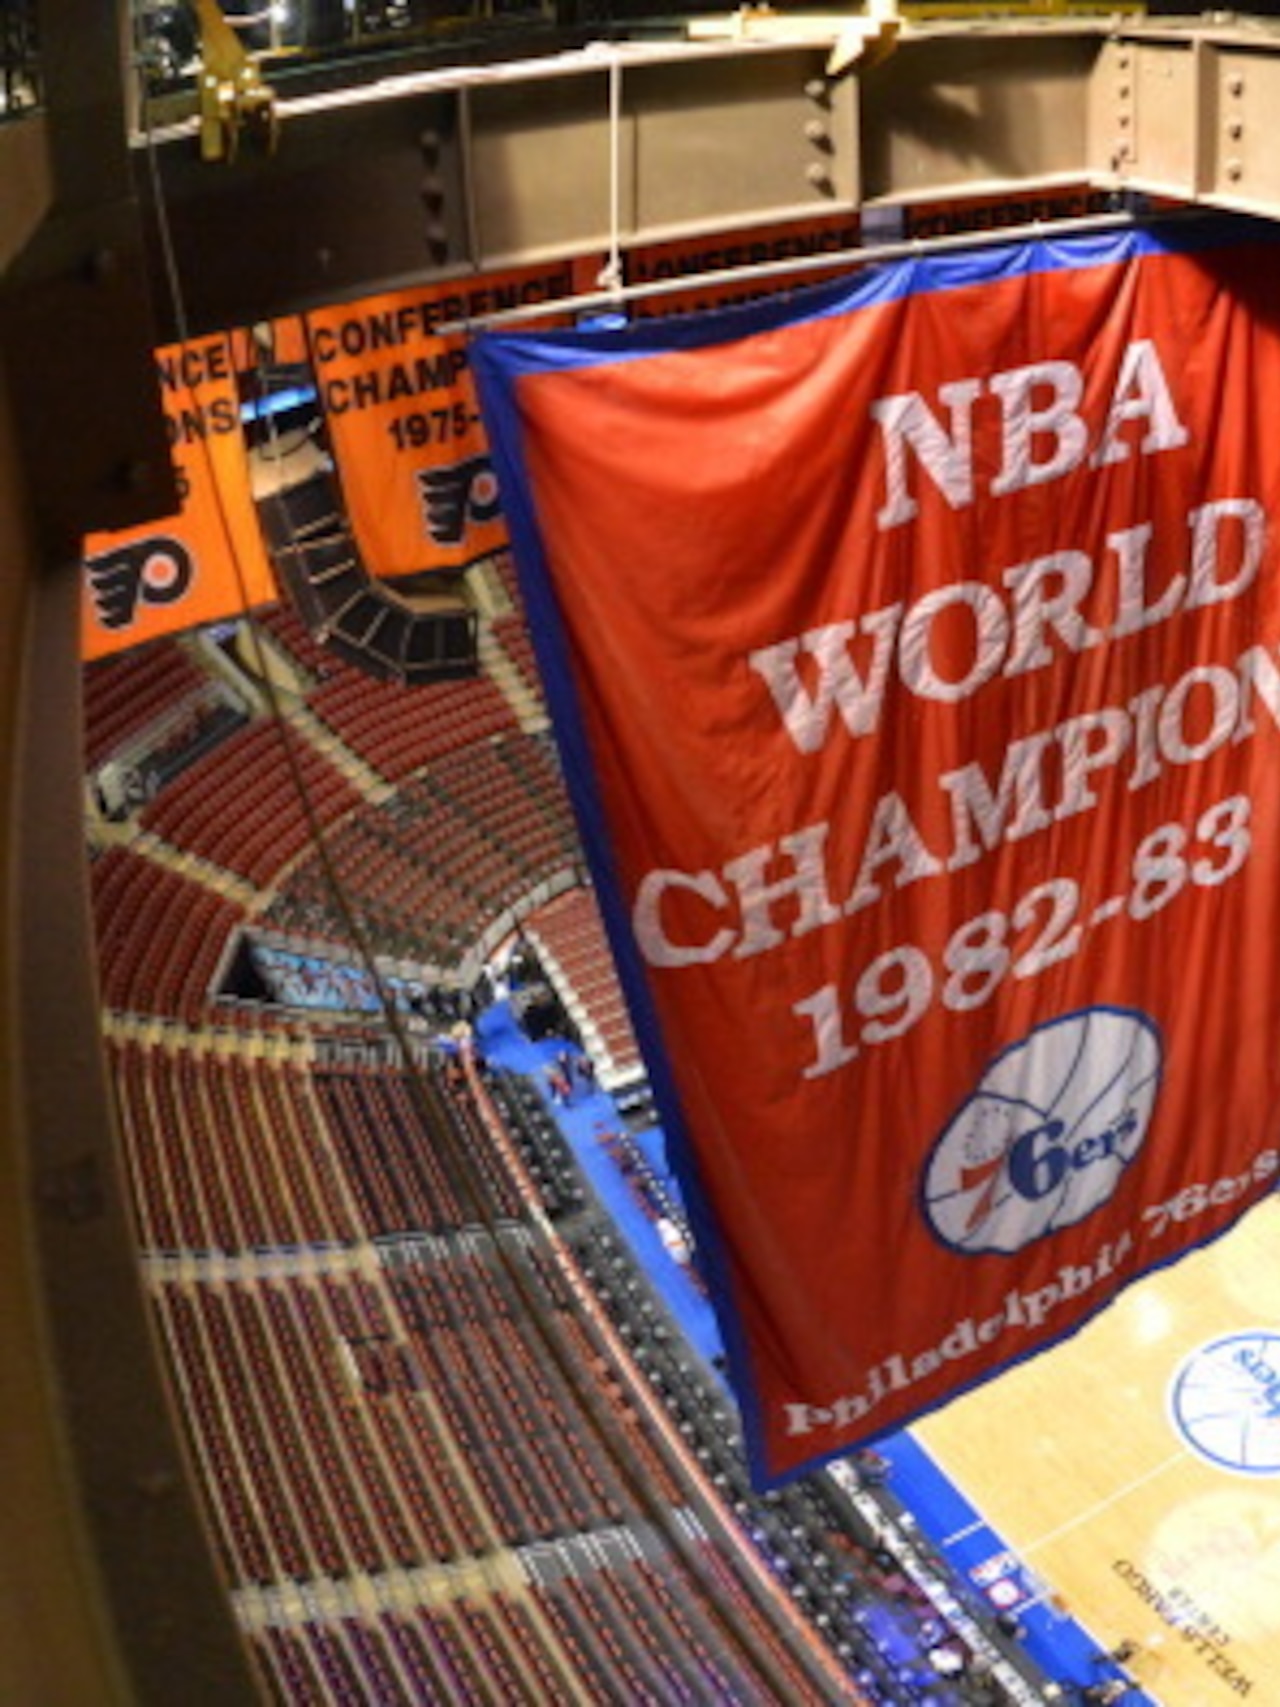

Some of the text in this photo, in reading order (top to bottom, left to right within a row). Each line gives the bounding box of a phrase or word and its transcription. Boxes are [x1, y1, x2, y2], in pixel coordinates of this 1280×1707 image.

[314, 275, 573, 362] CONFERENCE
[871, 339, 1190, 531] NBA
[749, 497, 1267, 755] WORLD
[792, 794, 1252, 1080] 1982-83
[783, 1231, 1132, 1436] Philadelphia
